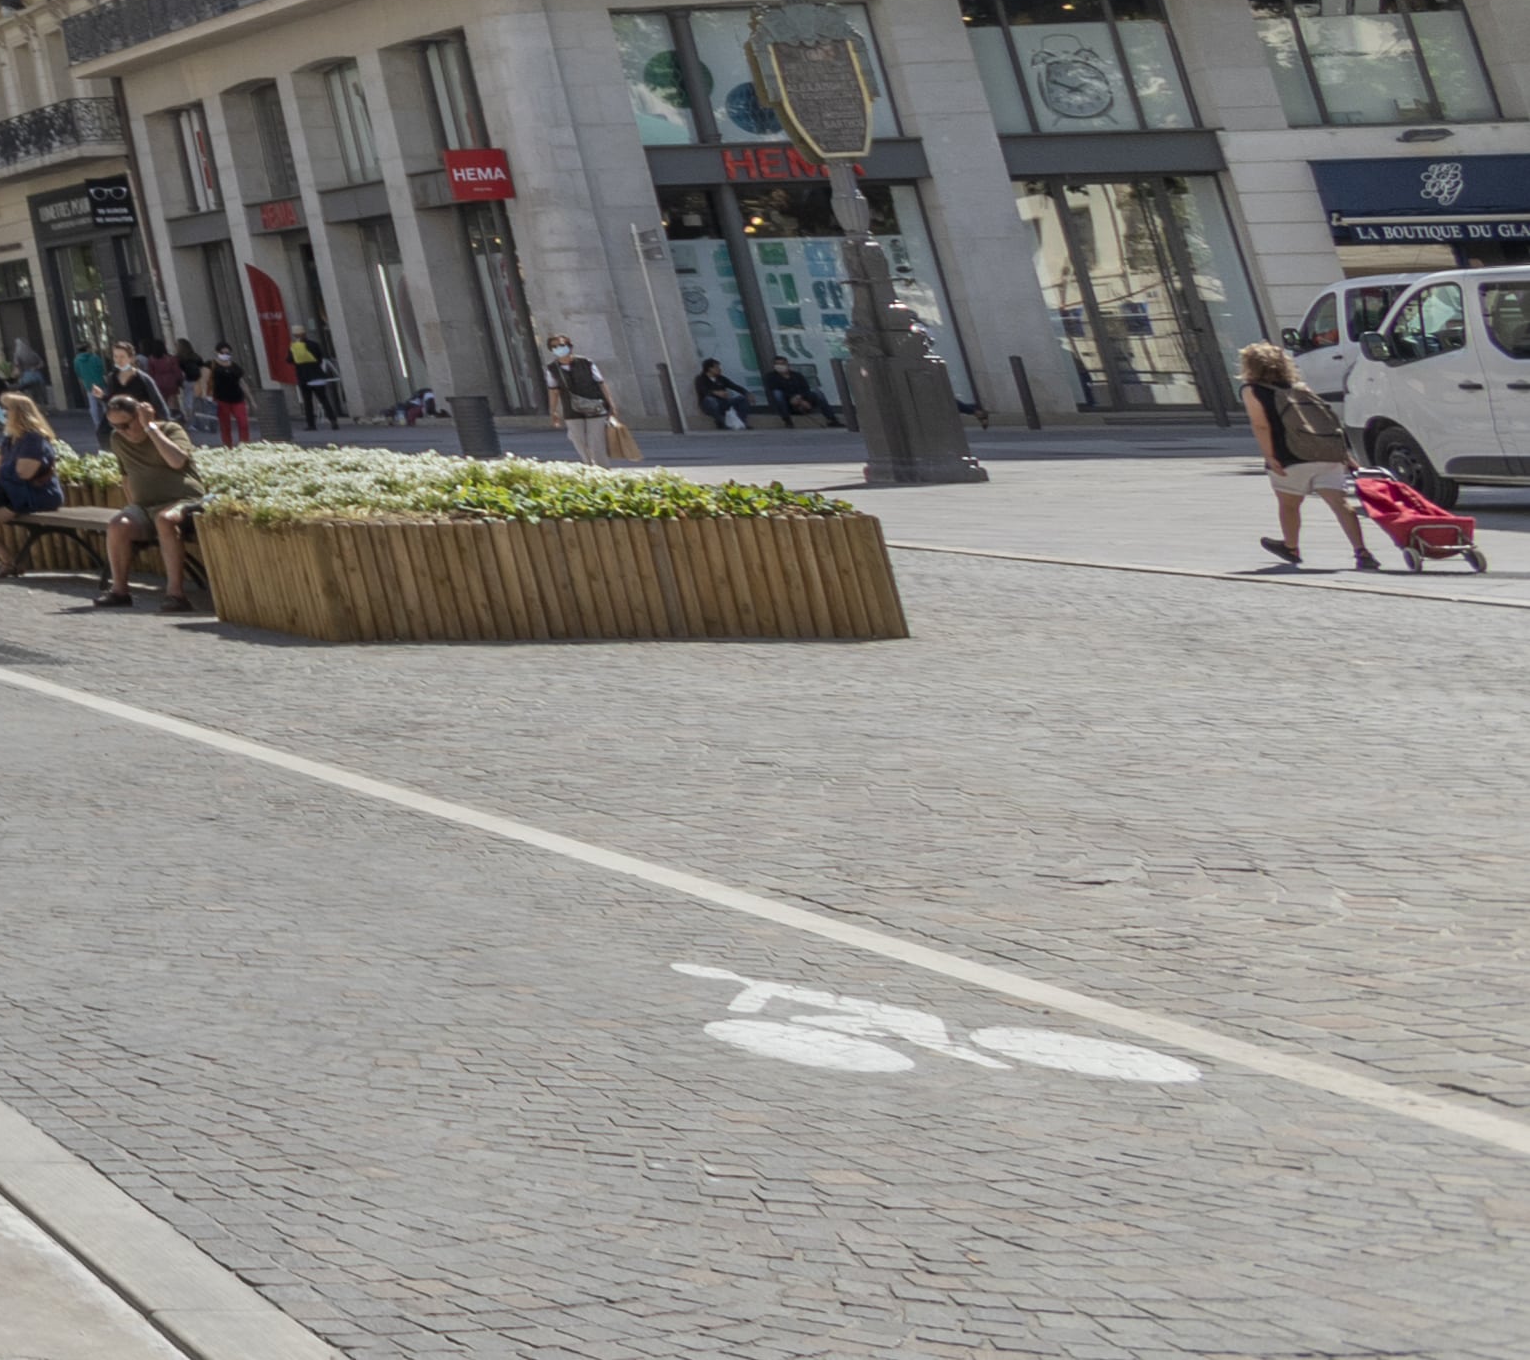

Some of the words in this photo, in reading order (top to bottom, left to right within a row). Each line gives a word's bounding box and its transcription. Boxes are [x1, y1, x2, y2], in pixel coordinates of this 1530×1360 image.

[451, 167, 507, 182] HEMA
[721, 147, 867, 180] HEM
[260, 200, 299, 230] HEMA
[1355, 227, 1379, 240] LA
[1382, 225, 1463, 241] BOUTIQUE
[1467, 224, 1493, 238] DU
